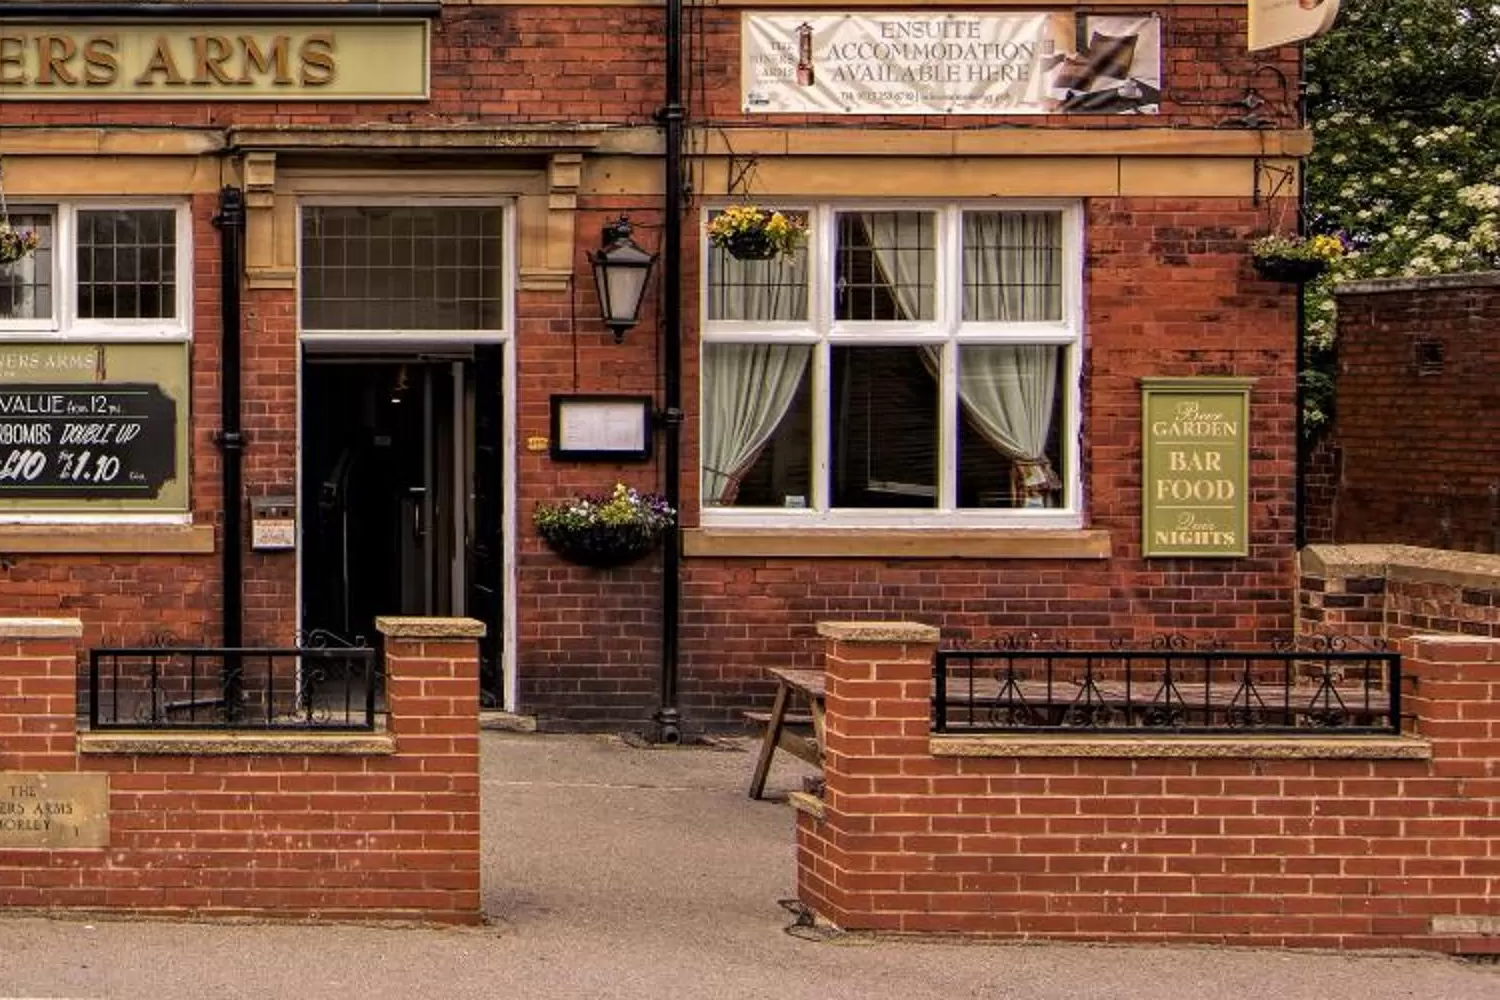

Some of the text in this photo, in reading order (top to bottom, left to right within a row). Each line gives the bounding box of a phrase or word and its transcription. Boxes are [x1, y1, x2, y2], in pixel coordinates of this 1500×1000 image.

[881, 21, 980, 39] ENSUITE
[135, 31, 337, 87] ARMS
[827, 42, 1034, 61] ACCOMMODATION
[831, 63, 1030, 82] AVAILABLE HERE
[44, 352, 93, 369] ARMS
[1173, 401, 1224, 422] Beer
[1152, 421, 1238, 437] GARDEN
[1170, 451, 1222, 471] BAR
[1157, 479, 1236, 500] FOOD
[1155, 531, 1236, 546] NIGHTS
[8, 786, 37, 797] THE
[33, 802, 73, 815] ARMS
